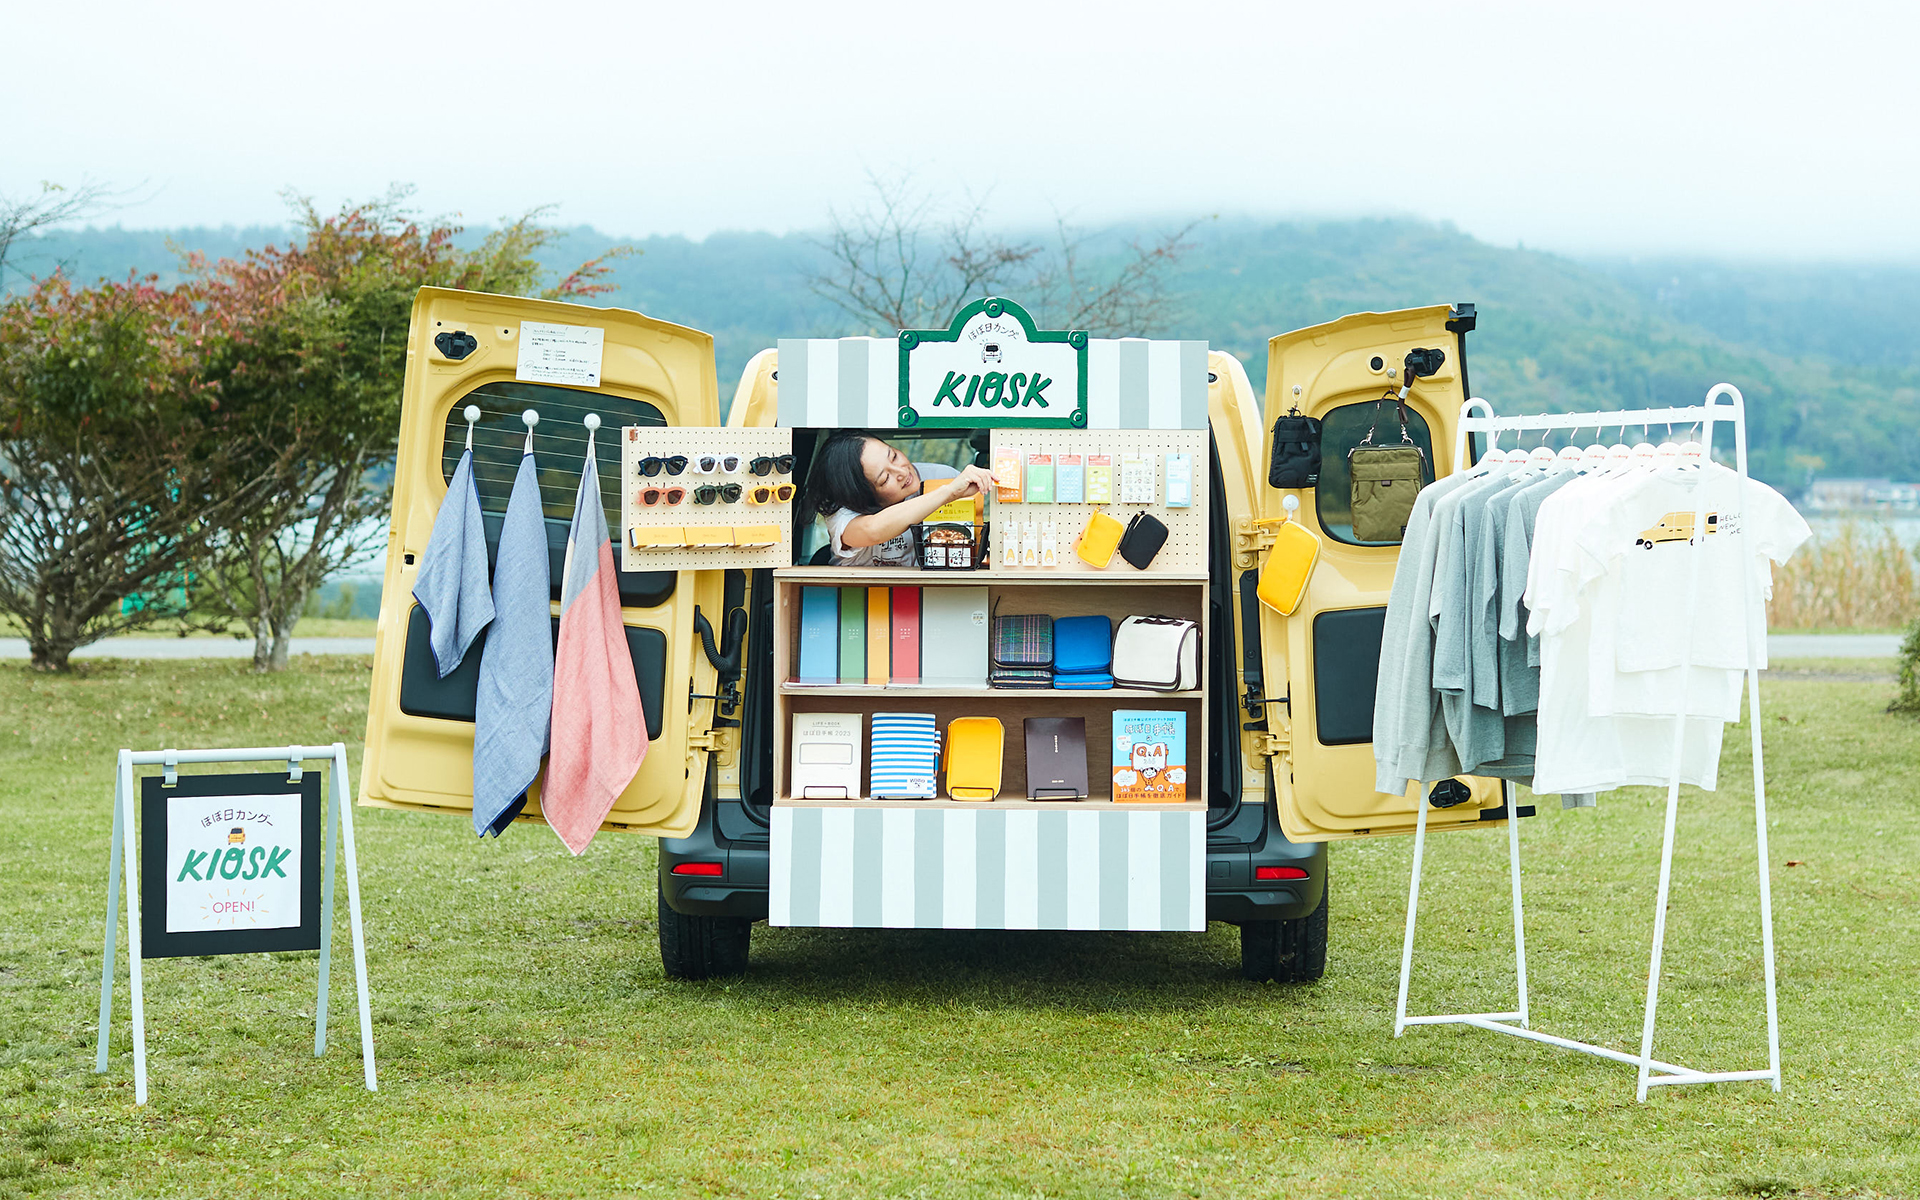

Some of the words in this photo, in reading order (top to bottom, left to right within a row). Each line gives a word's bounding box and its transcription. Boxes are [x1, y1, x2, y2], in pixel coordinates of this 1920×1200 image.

[968, 322, 1020, 341] ほぼ日カングー
[932, 371, 1053, 409] KIOSK
[802, 729, 833, 737] ほぼ日手帳
[1124, 722, 1176, 736] ほぼ日手帳
[1136, 745, 1162, 758] Q&A
[200, 808, 274, 828] ほぼ日カングー
[176, 845, 292, 883] KIOSK
[212, 901, 255, 914] OPEN!
